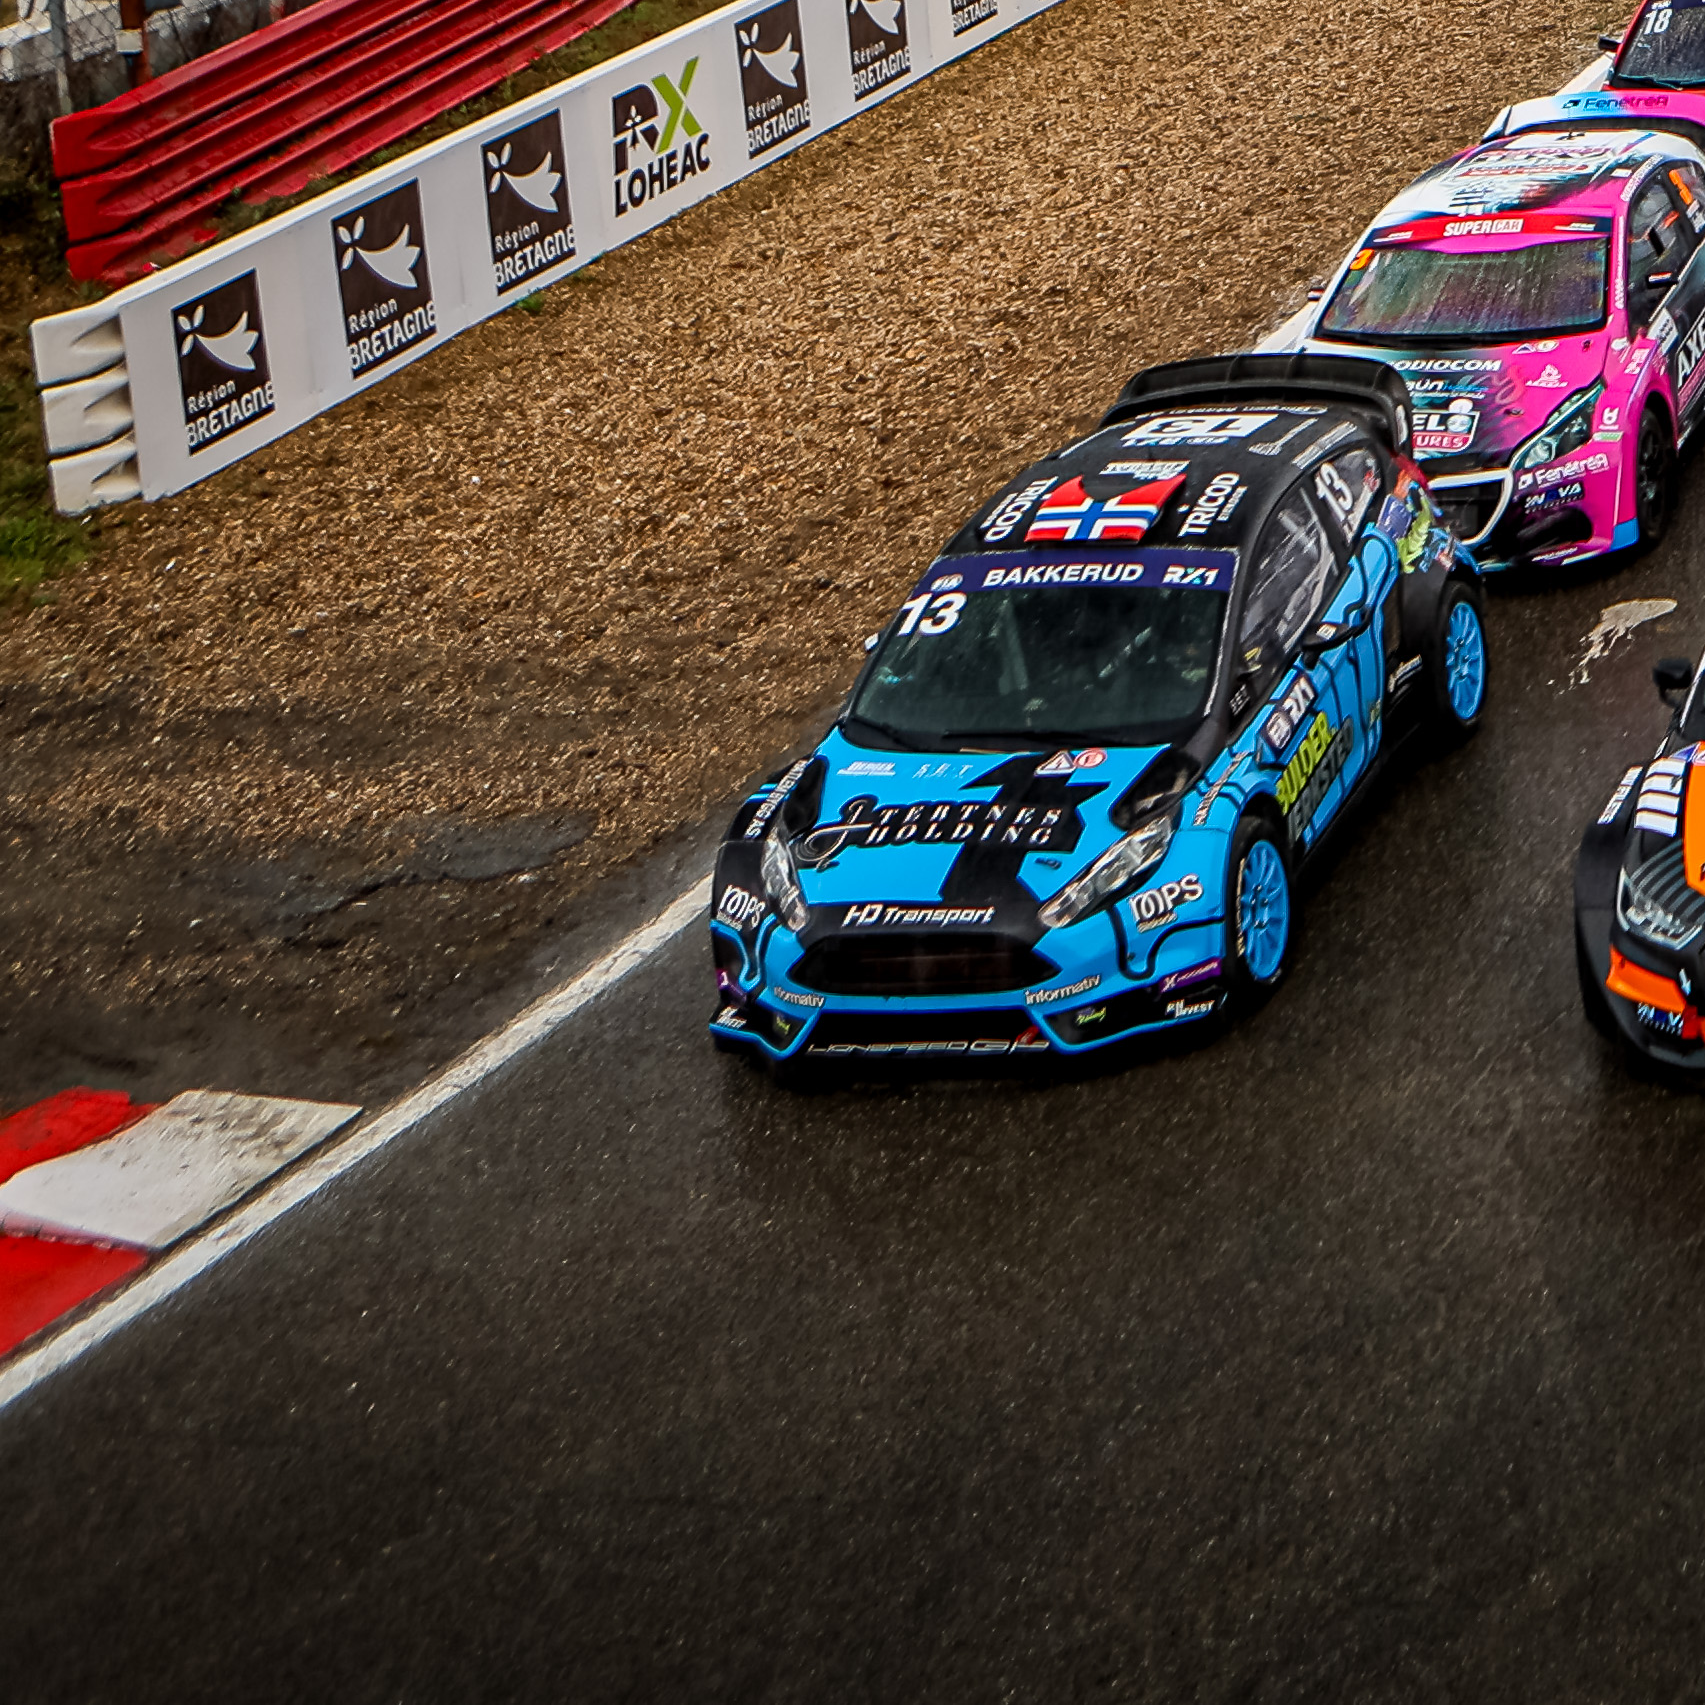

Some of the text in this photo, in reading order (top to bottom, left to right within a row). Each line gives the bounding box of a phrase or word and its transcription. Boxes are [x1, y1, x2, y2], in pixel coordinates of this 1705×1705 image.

[1644, 9, 1672, 35] 18
[747, 94, 785, 127] Région
[747, 98, 813, 153] BRETAGNE
[615, 132, 712, 218] LOHEAC
[494, 221, 540, 255] Région
[494, 225, 577, 290] BRETAGNE
[347, 295, 399, 335] Région
[349, 301, 437, 371] BRETAGNE
[1391, 359, 1501, 372] ODIOCOM
[186, 377, 238, 415] Région
[186, 381, 276, 447] BRETAGNE
[984, 476, 1058, 542] TRICOD
[1179, 472, 1240, 536] TRICOD
[1313, 462, 1353, 520] 13
[982, 563, 1144, 587] BAKKERUD
[899, 592, 967, 635] 13
[880, 804, 1063, 825] TERTNES
[865, 826, 1053, 844] HOLDING
[881, 906, 996, 926] Transport
[1025, 974, 1101, 1004] informativ
